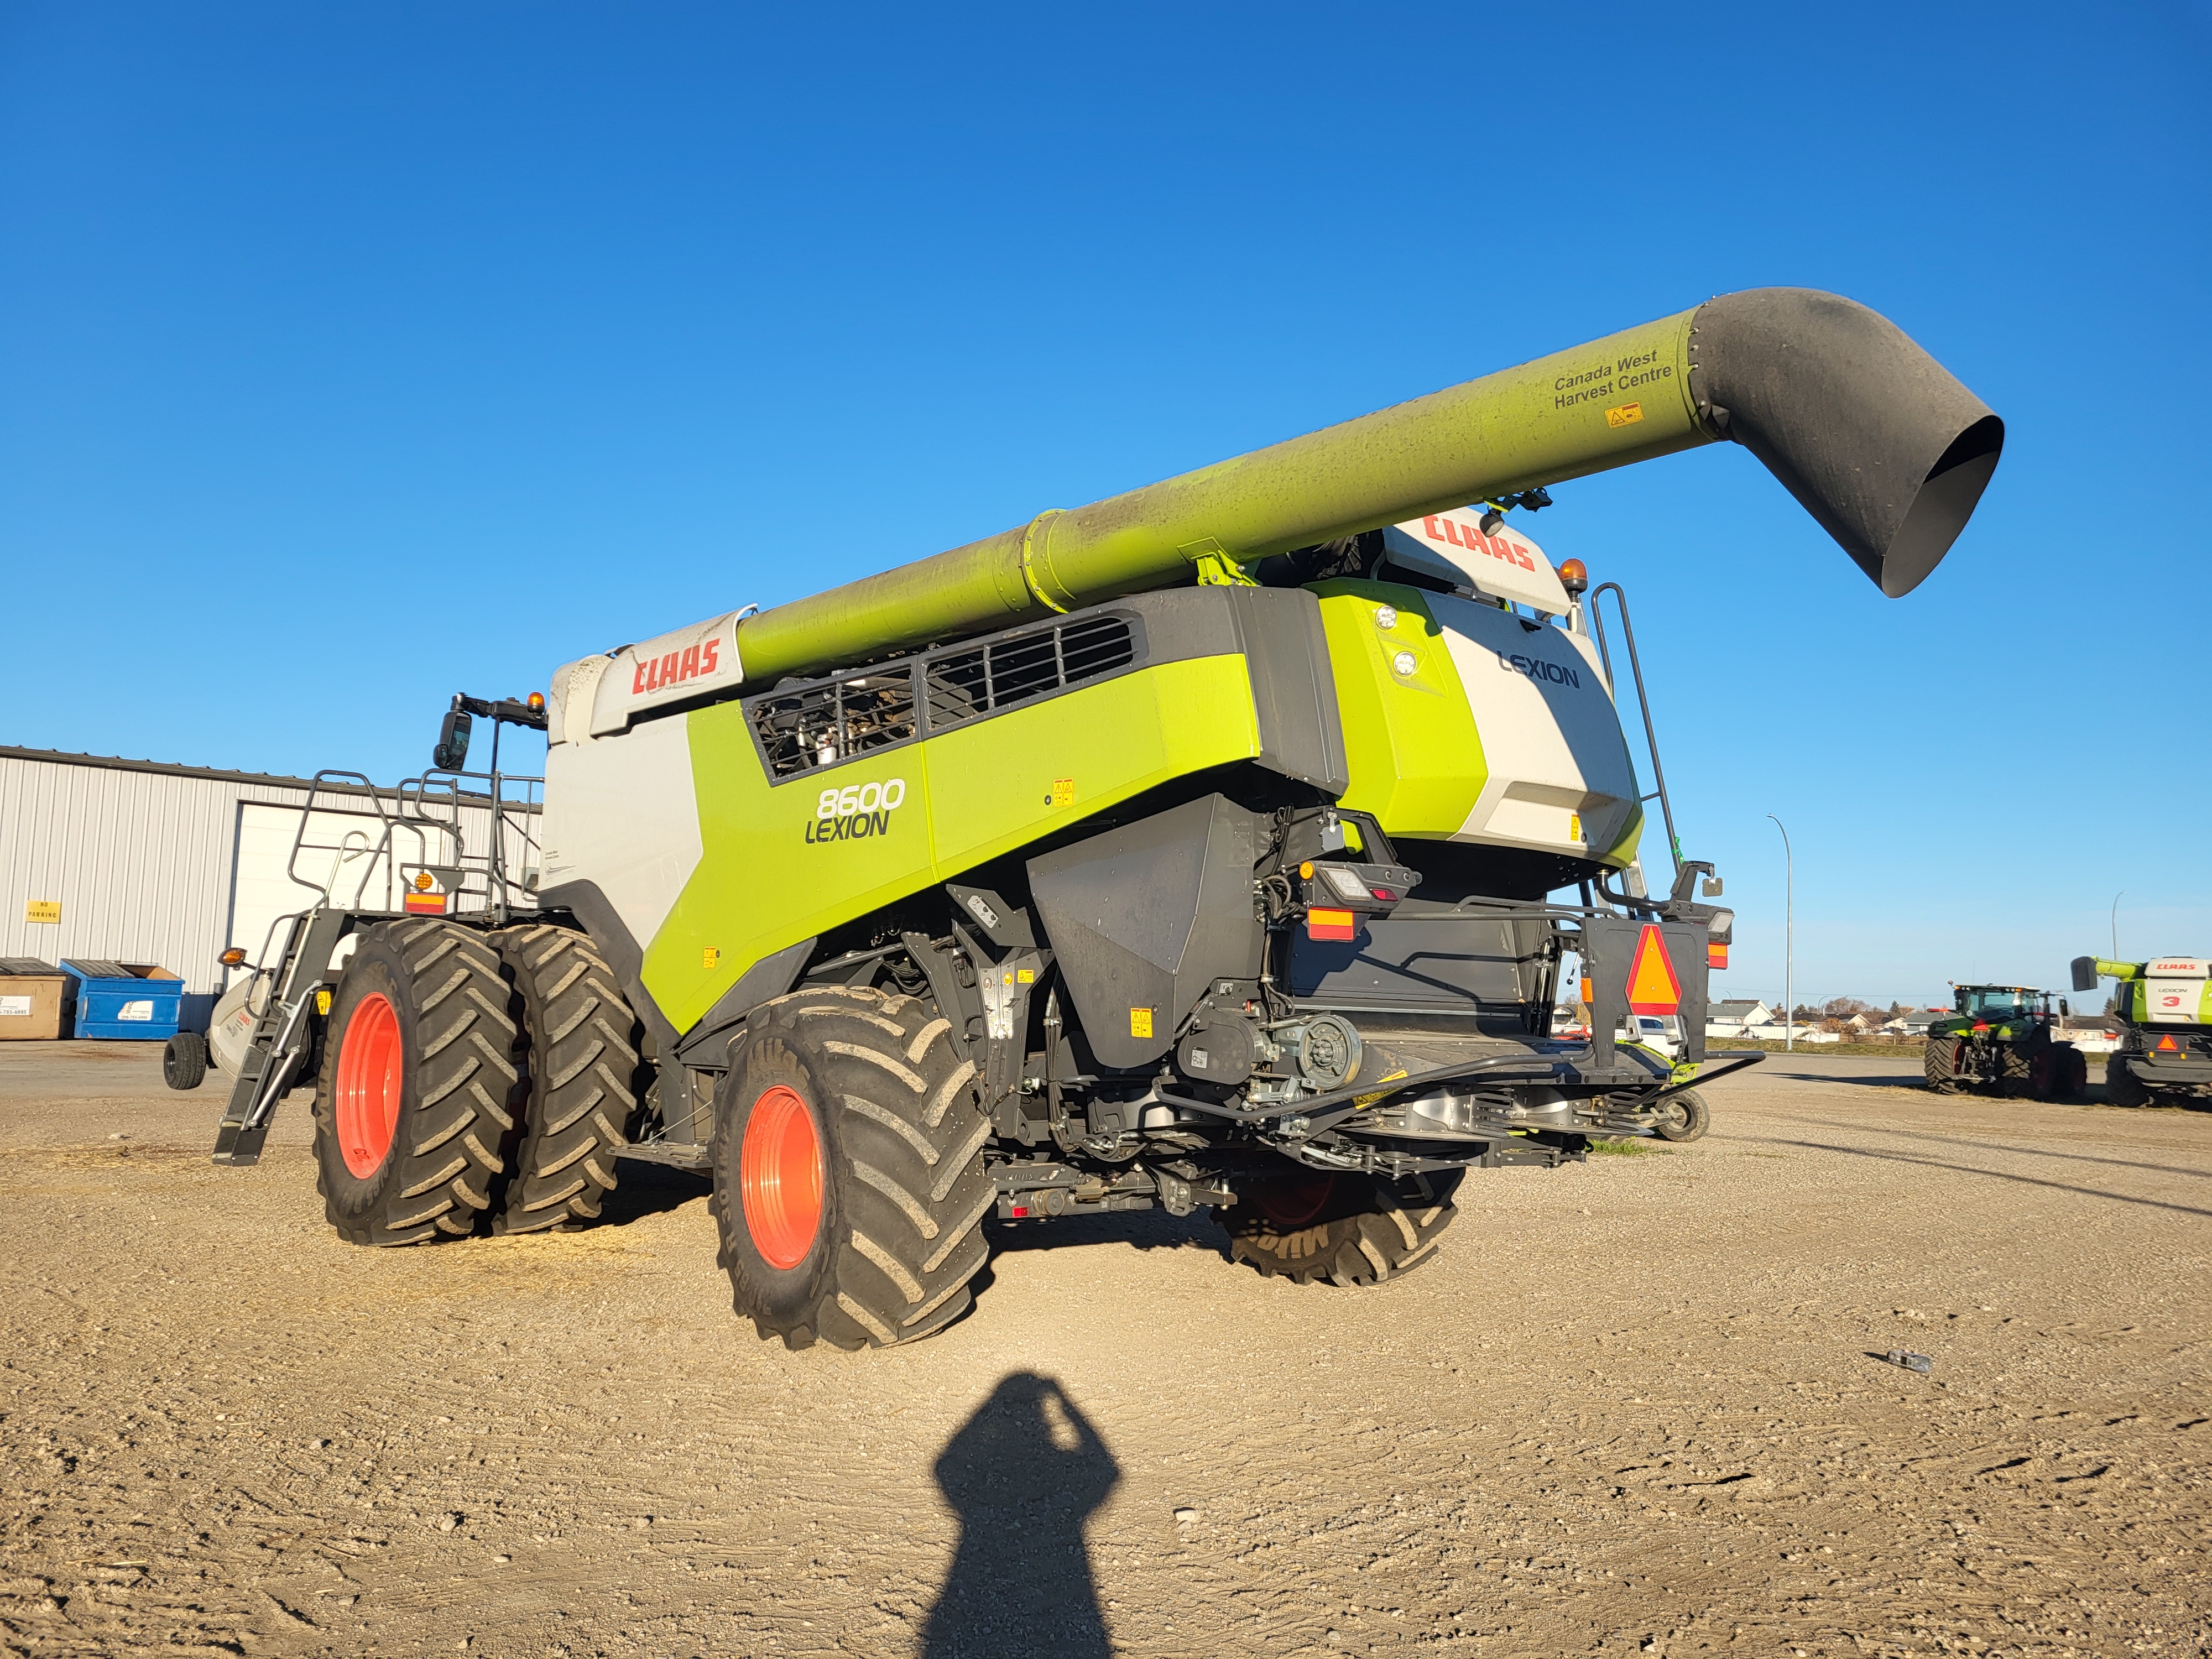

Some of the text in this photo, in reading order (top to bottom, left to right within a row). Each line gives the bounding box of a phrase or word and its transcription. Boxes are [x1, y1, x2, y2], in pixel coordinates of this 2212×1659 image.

[1554, 349, 1658, 391] Canada West
[1554, 366, 1672, 410] Harvest Centre
[1423, 514, 1536, 572] CLAAS
[632, 638, 721, 695] CLAAS
[1497, 650, 1580, 690] LEXION
[817, 779, 905, 819] 8600
[805, 810, 890, 844] LEXION
[2162, 996, 2180, 1006] 3
